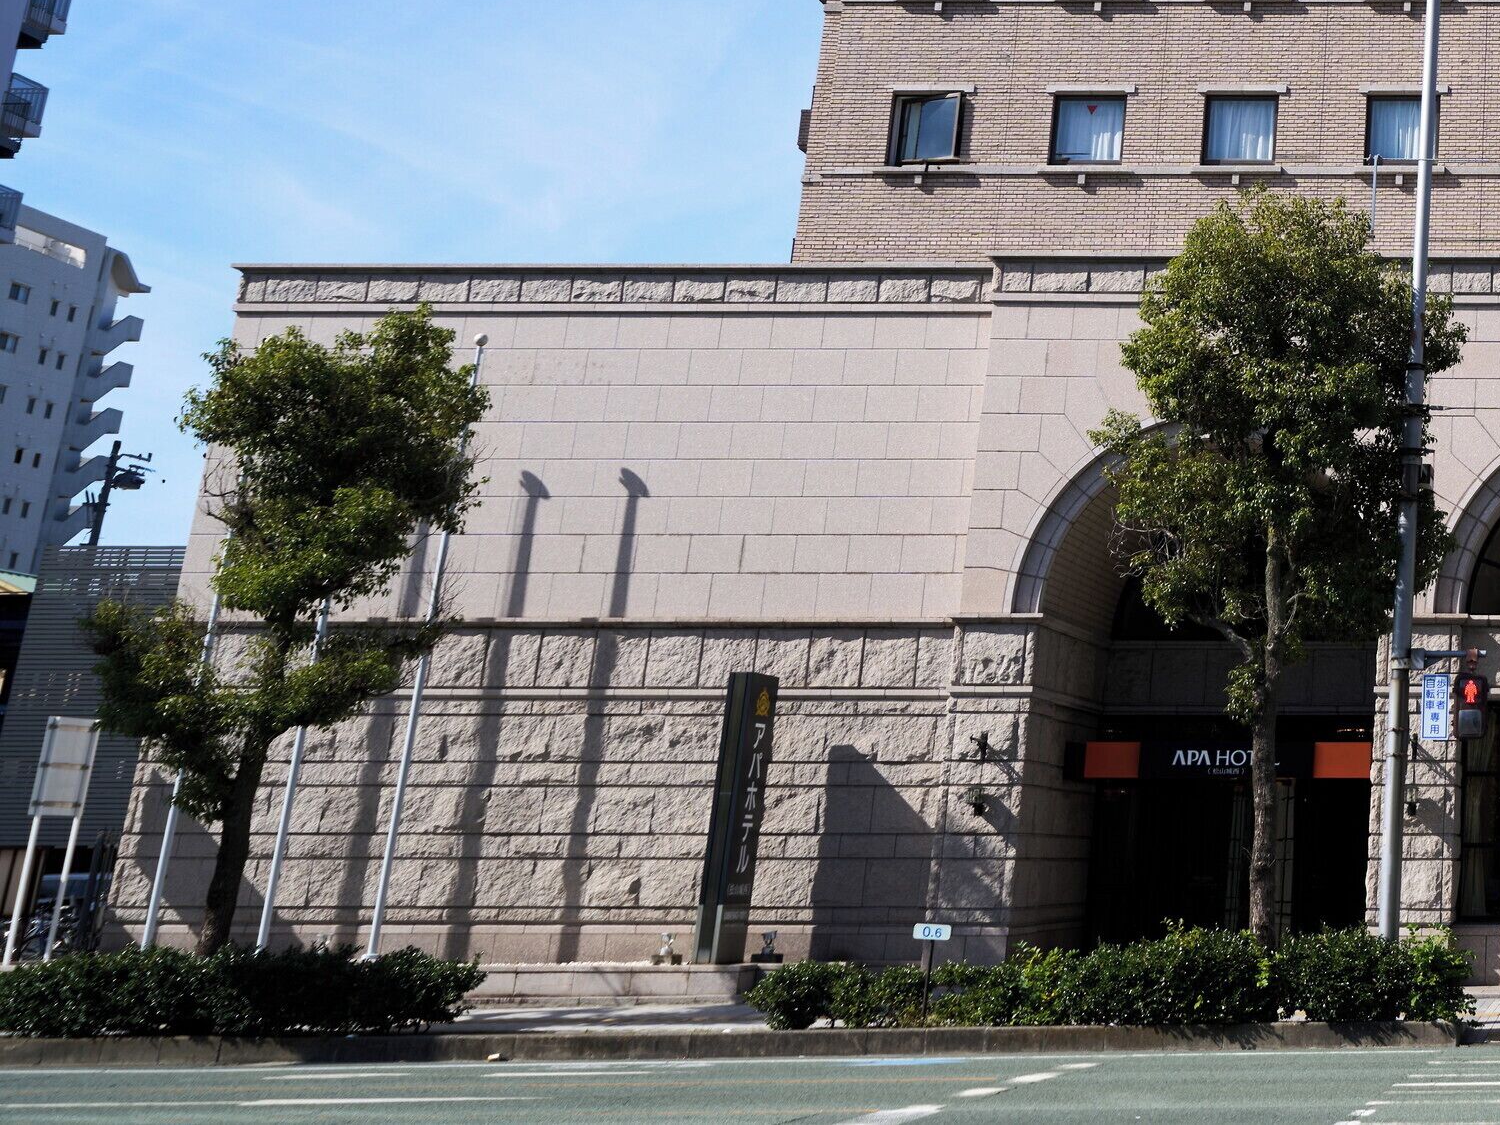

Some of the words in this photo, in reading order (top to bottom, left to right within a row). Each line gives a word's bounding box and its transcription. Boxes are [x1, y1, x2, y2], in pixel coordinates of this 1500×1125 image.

[1425, 678, 1435, 710] 自転車
[1436, 678, 1446, 710] 歩行者
[1429, 712, 1440, 735] 専用
[1172, 749, 1211, 766] APA
[735, 722, 766, 875] アパホテル
[922, 926, 942, 938] 0.6
